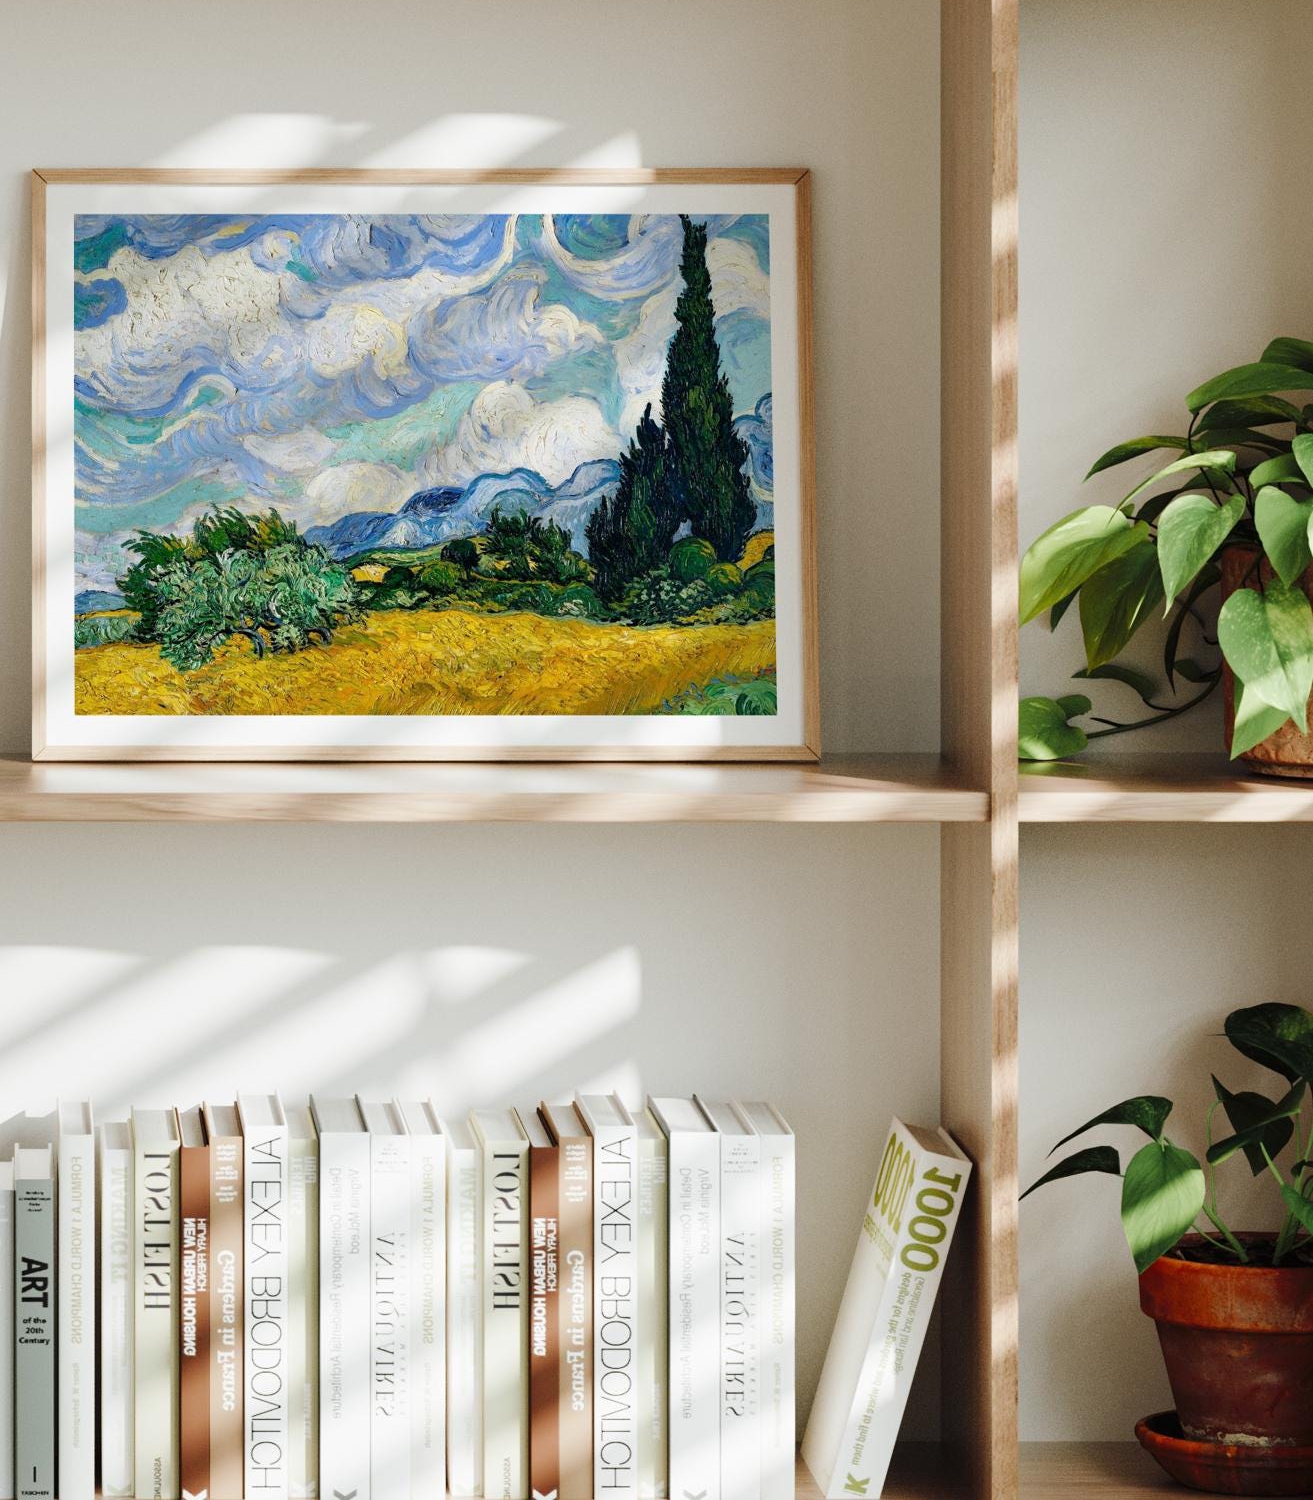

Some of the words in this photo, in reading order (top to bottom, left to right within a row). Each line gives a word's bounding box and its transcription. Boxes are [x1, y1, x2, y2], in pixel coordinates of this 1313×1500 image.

[21, 1256, 48, 1308] ART
[24, 1327, 45, 1335] 20th
[18, 1337, 50, 1345] Century
